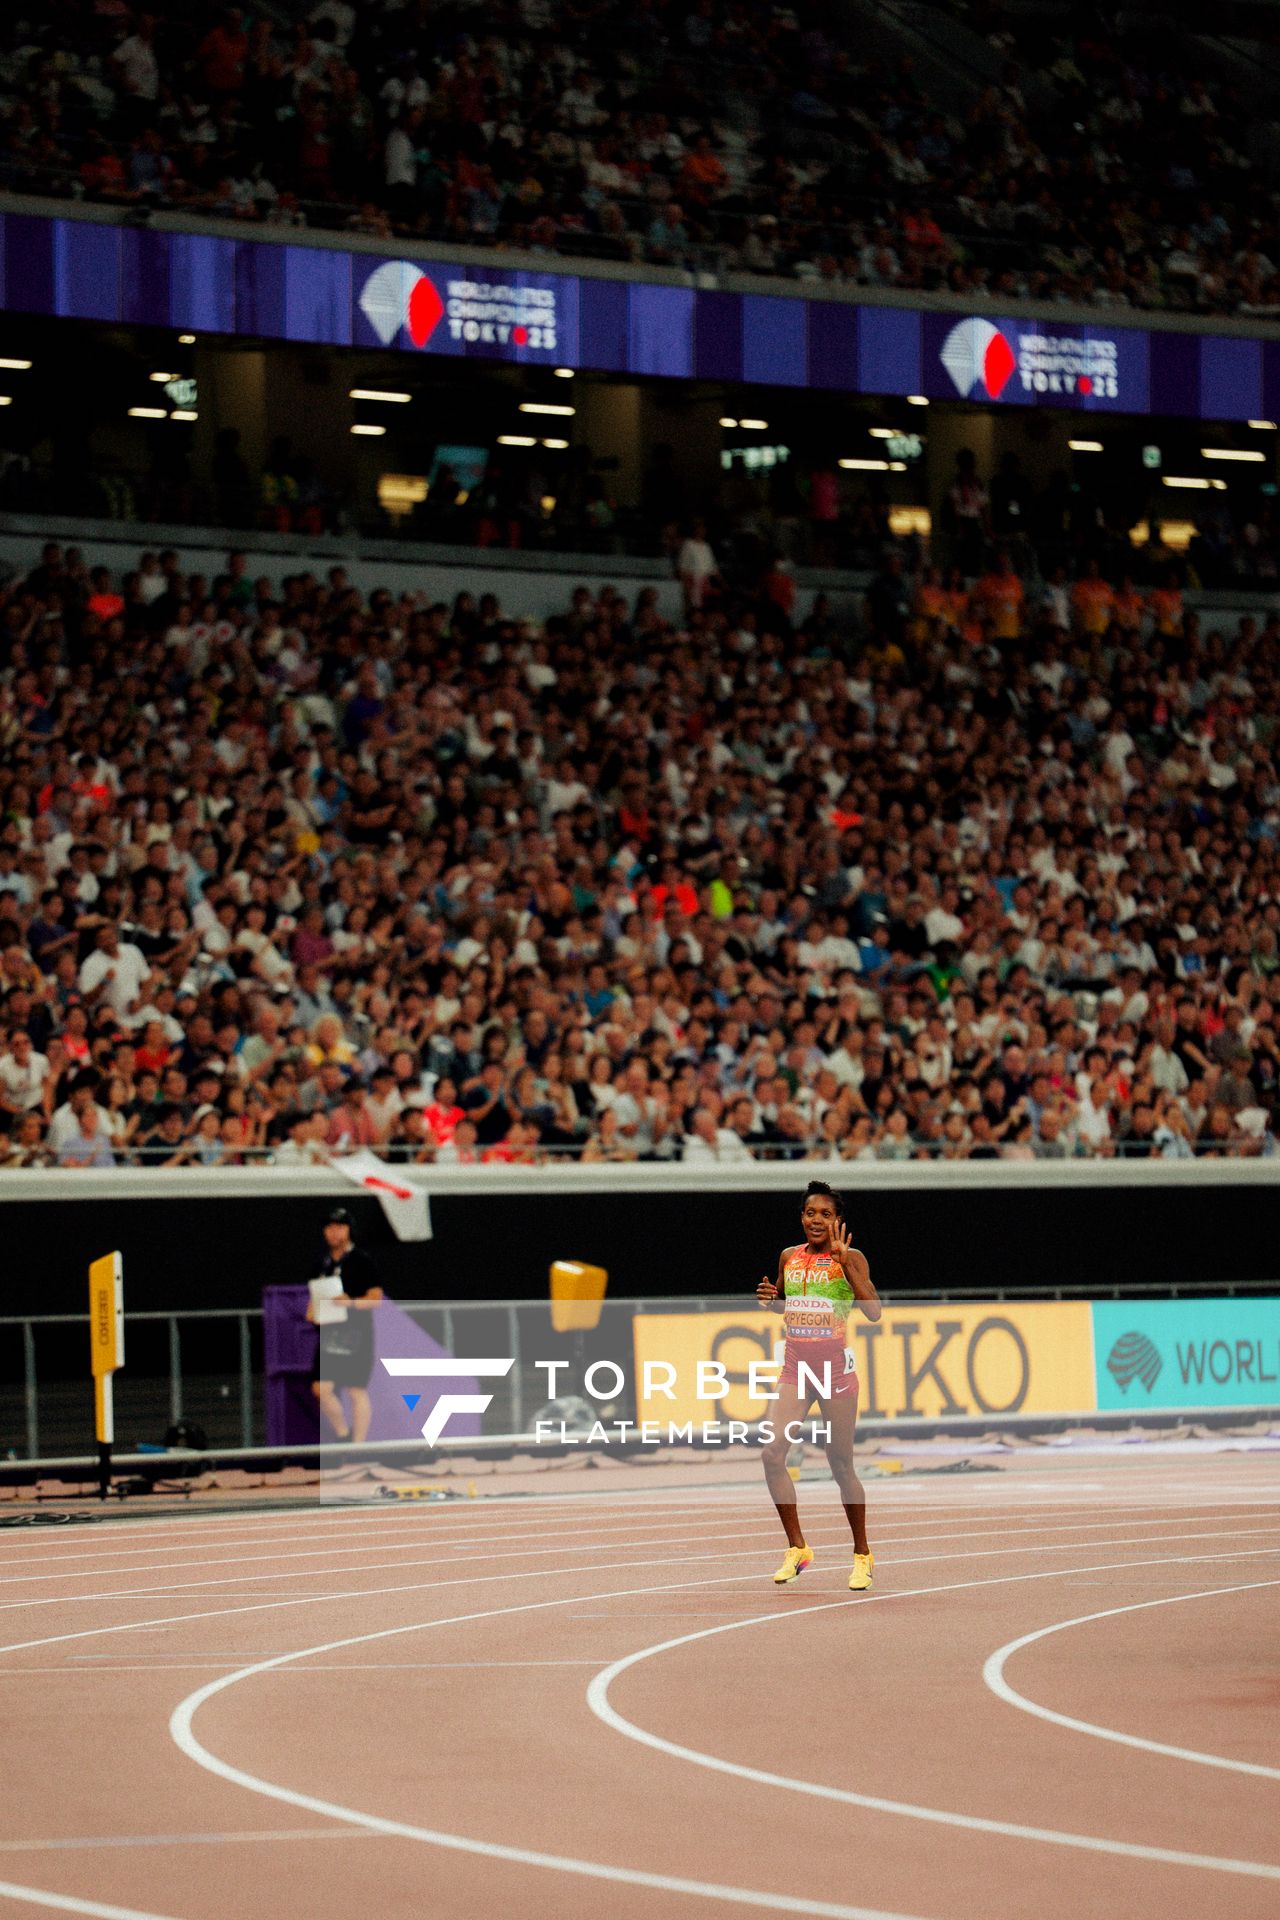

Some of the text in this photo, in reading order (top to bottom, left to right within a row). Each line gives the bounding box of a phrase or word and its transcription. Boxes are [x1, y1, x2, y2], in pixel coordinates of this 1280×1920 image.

[786, 1269, 830, 1285] KENYA
[786, 1299, 832, 1308] HONDA
[711, 1317, 1030, 1424] SIKO
